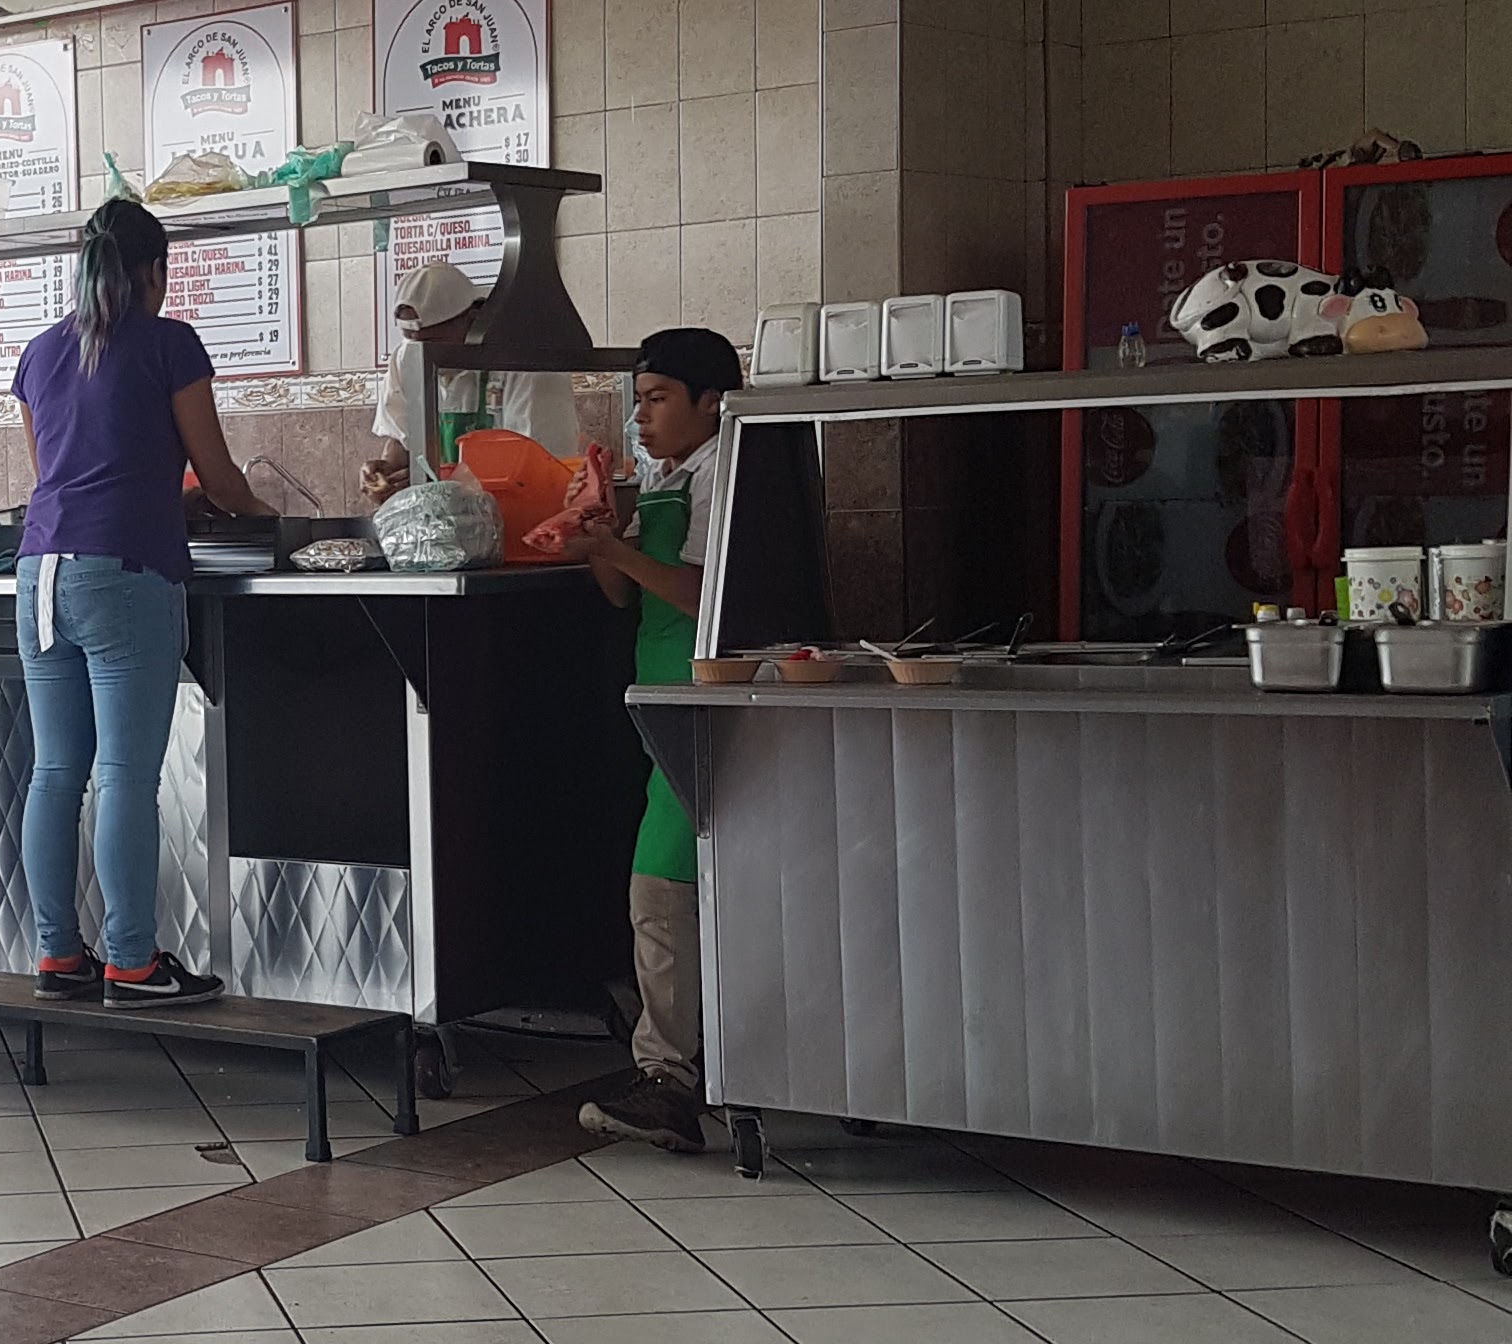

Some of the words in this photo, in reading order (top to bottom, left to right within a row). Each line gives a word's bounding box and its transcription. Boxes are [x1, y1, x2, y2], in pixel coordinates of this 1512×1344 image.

[426, 4, 447, 36] ARCO
[483, 14, 498, 44] JUAN
[205, 32, 218, 43] DE
[220, 32, 238, 48] SAN
[422, 39, 431, 53] EL
[185, 39, 204, 70] ARCO
[235, 48, 250, 76] JUAN
[8, 65, 25, 80] SAN
[426, 61, 454, 74] Tacos
[456, 61, 463, 71] y
[466, 59, 495, 70] Tortas
[182, 72, 189, 85] EL
[187, 93, 211, 103] Tacos
[212, 93, 218, 101] y
[221, 91, 246, 102] Tortas
[442, 96, 481, 111] MENU
[443, 104, 526, 130] ACHERA
[200, 132, 235, 146] MENU
[516, 132, 529, 147] 17
[394, 225, 424, 240] TORTA
[427, 220, 471, 238] C/QUESO
[394, 238, 452, 256] QUESADILLA
[454, 234, 490, 250] HARINA
[168, 251, 188, 264] ORTA
[191, 247, 228, 263] C/QUESO
[394, 256, 419, 271] TACO
[169, 264, 212, 279] UESADILLA
[214, 261, 245, 275] HARINA
[268, 259, 280, 272] 29
[169, 281, 185, 294] ACO
[187, 279, 211, 292] LIGHT
[268, 274, 279, 287] 27
[187, 292, 215, 307] TROZO
[268, 288, 280, 300] 29
[268, 302, 279, 315] 27
[269, 330, 279, 343] 19
[0, 345, 21, 358] LITRO
[1462, 391, 1492, 432] te
[1421, 393, 1451, 478] usto.
